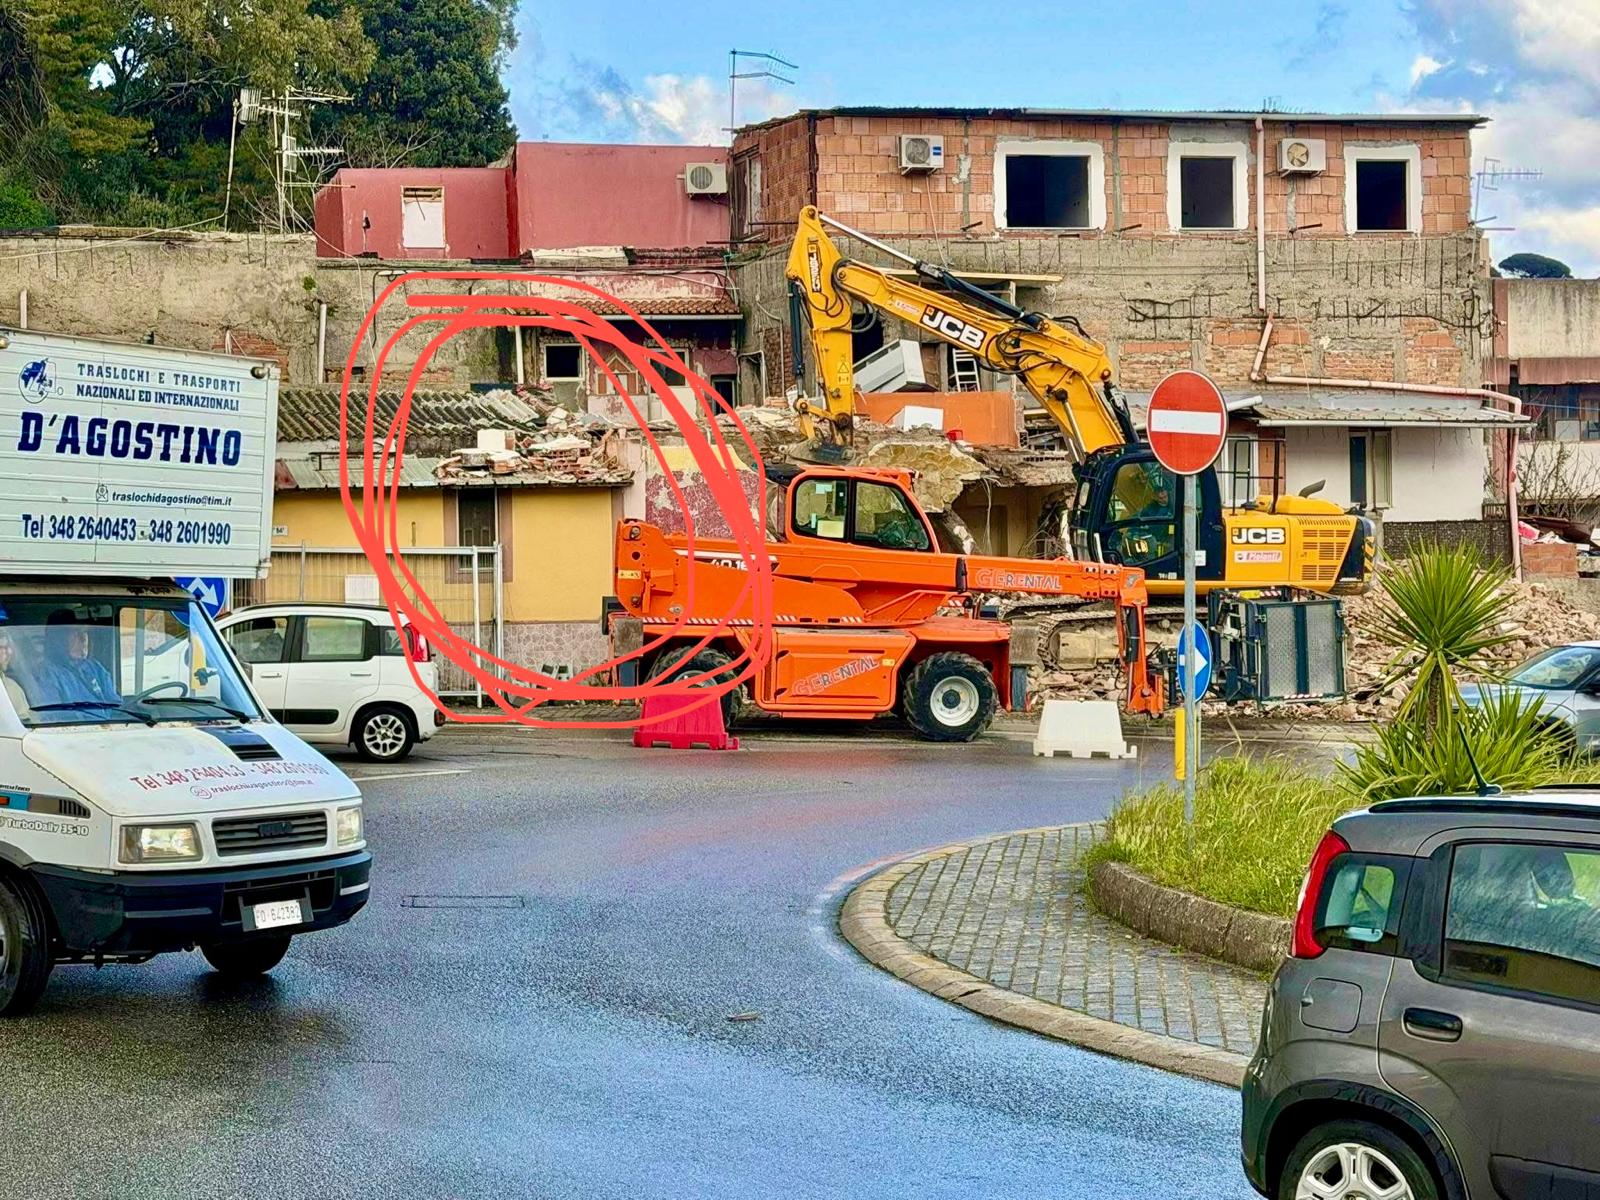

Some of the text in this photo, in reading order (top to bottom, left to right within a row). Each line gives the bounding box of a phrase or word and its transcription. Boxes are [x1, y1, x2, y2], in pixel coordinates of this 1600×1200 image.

[921, 306, 986, 349] JCB
[77, 363, 241, 393] TRASLOCHI E TRASPORTI
[76, 384, 239, 412] NAZIONALI ED INTERNAZIONALI
[17, 411, 242, 467] D'AGOSTINO
[112, 491, 232, 507] traslochidagostino@tim.it
[22, 514, 44, 539] Tel
[49, 515, 74, 540] 348
[77, 516, 136, 542] 2640453
[149, 520, 172, 543] 348
[176, 521, 231, 545] 2601990
[1231, 528, 1286, 545] JCB
[130, 775, 160, 791] Tel
[157, 770, 187, 786] 348
[7, 818, 59, 833] TurboDaily
